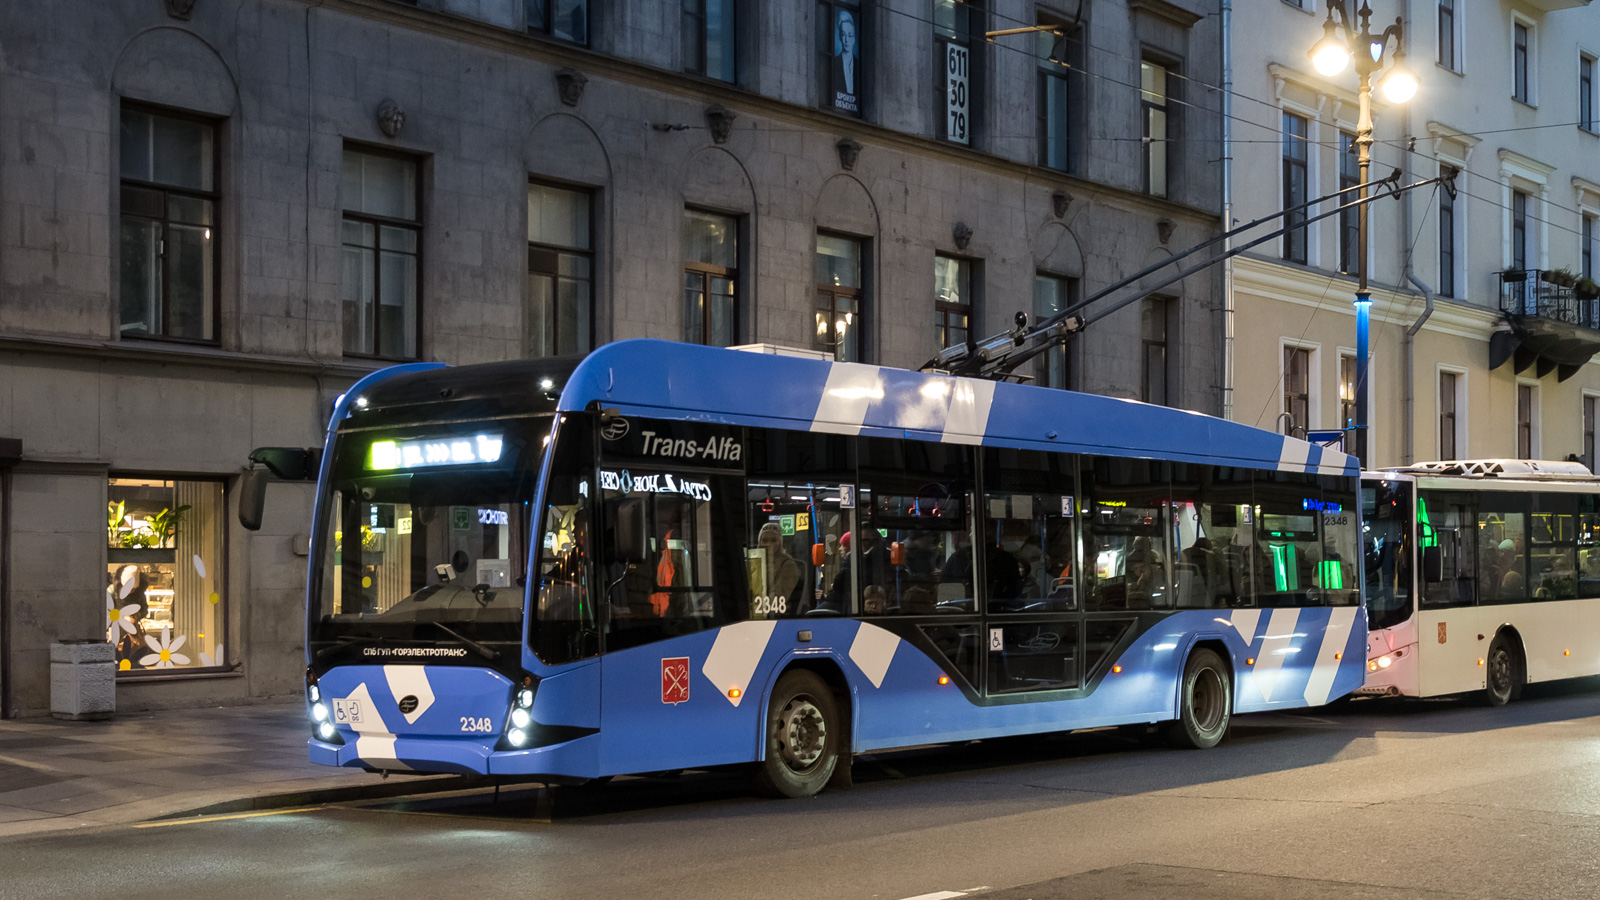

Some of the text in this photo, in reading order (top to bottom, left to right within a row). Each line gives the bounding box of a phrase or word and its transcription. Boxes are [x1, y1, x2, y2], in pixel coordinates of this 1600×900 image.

[949, 47, 967, 78] 611
[836, 91, 856, 103] БРОКЕР
[950, 79, 966, 109] 30
[835, 99, 858, 112] ОБЪЕКТА
[950, 111, 966, 140] 79
[641, 430, 742, 461] Trans-Alfa
[1324, 516, 1348, 526] 2348
[754, 596, 787, 614] 2348
[377, 648, 391, 656] ГУП
[460, 717, 492, 733] 2348
